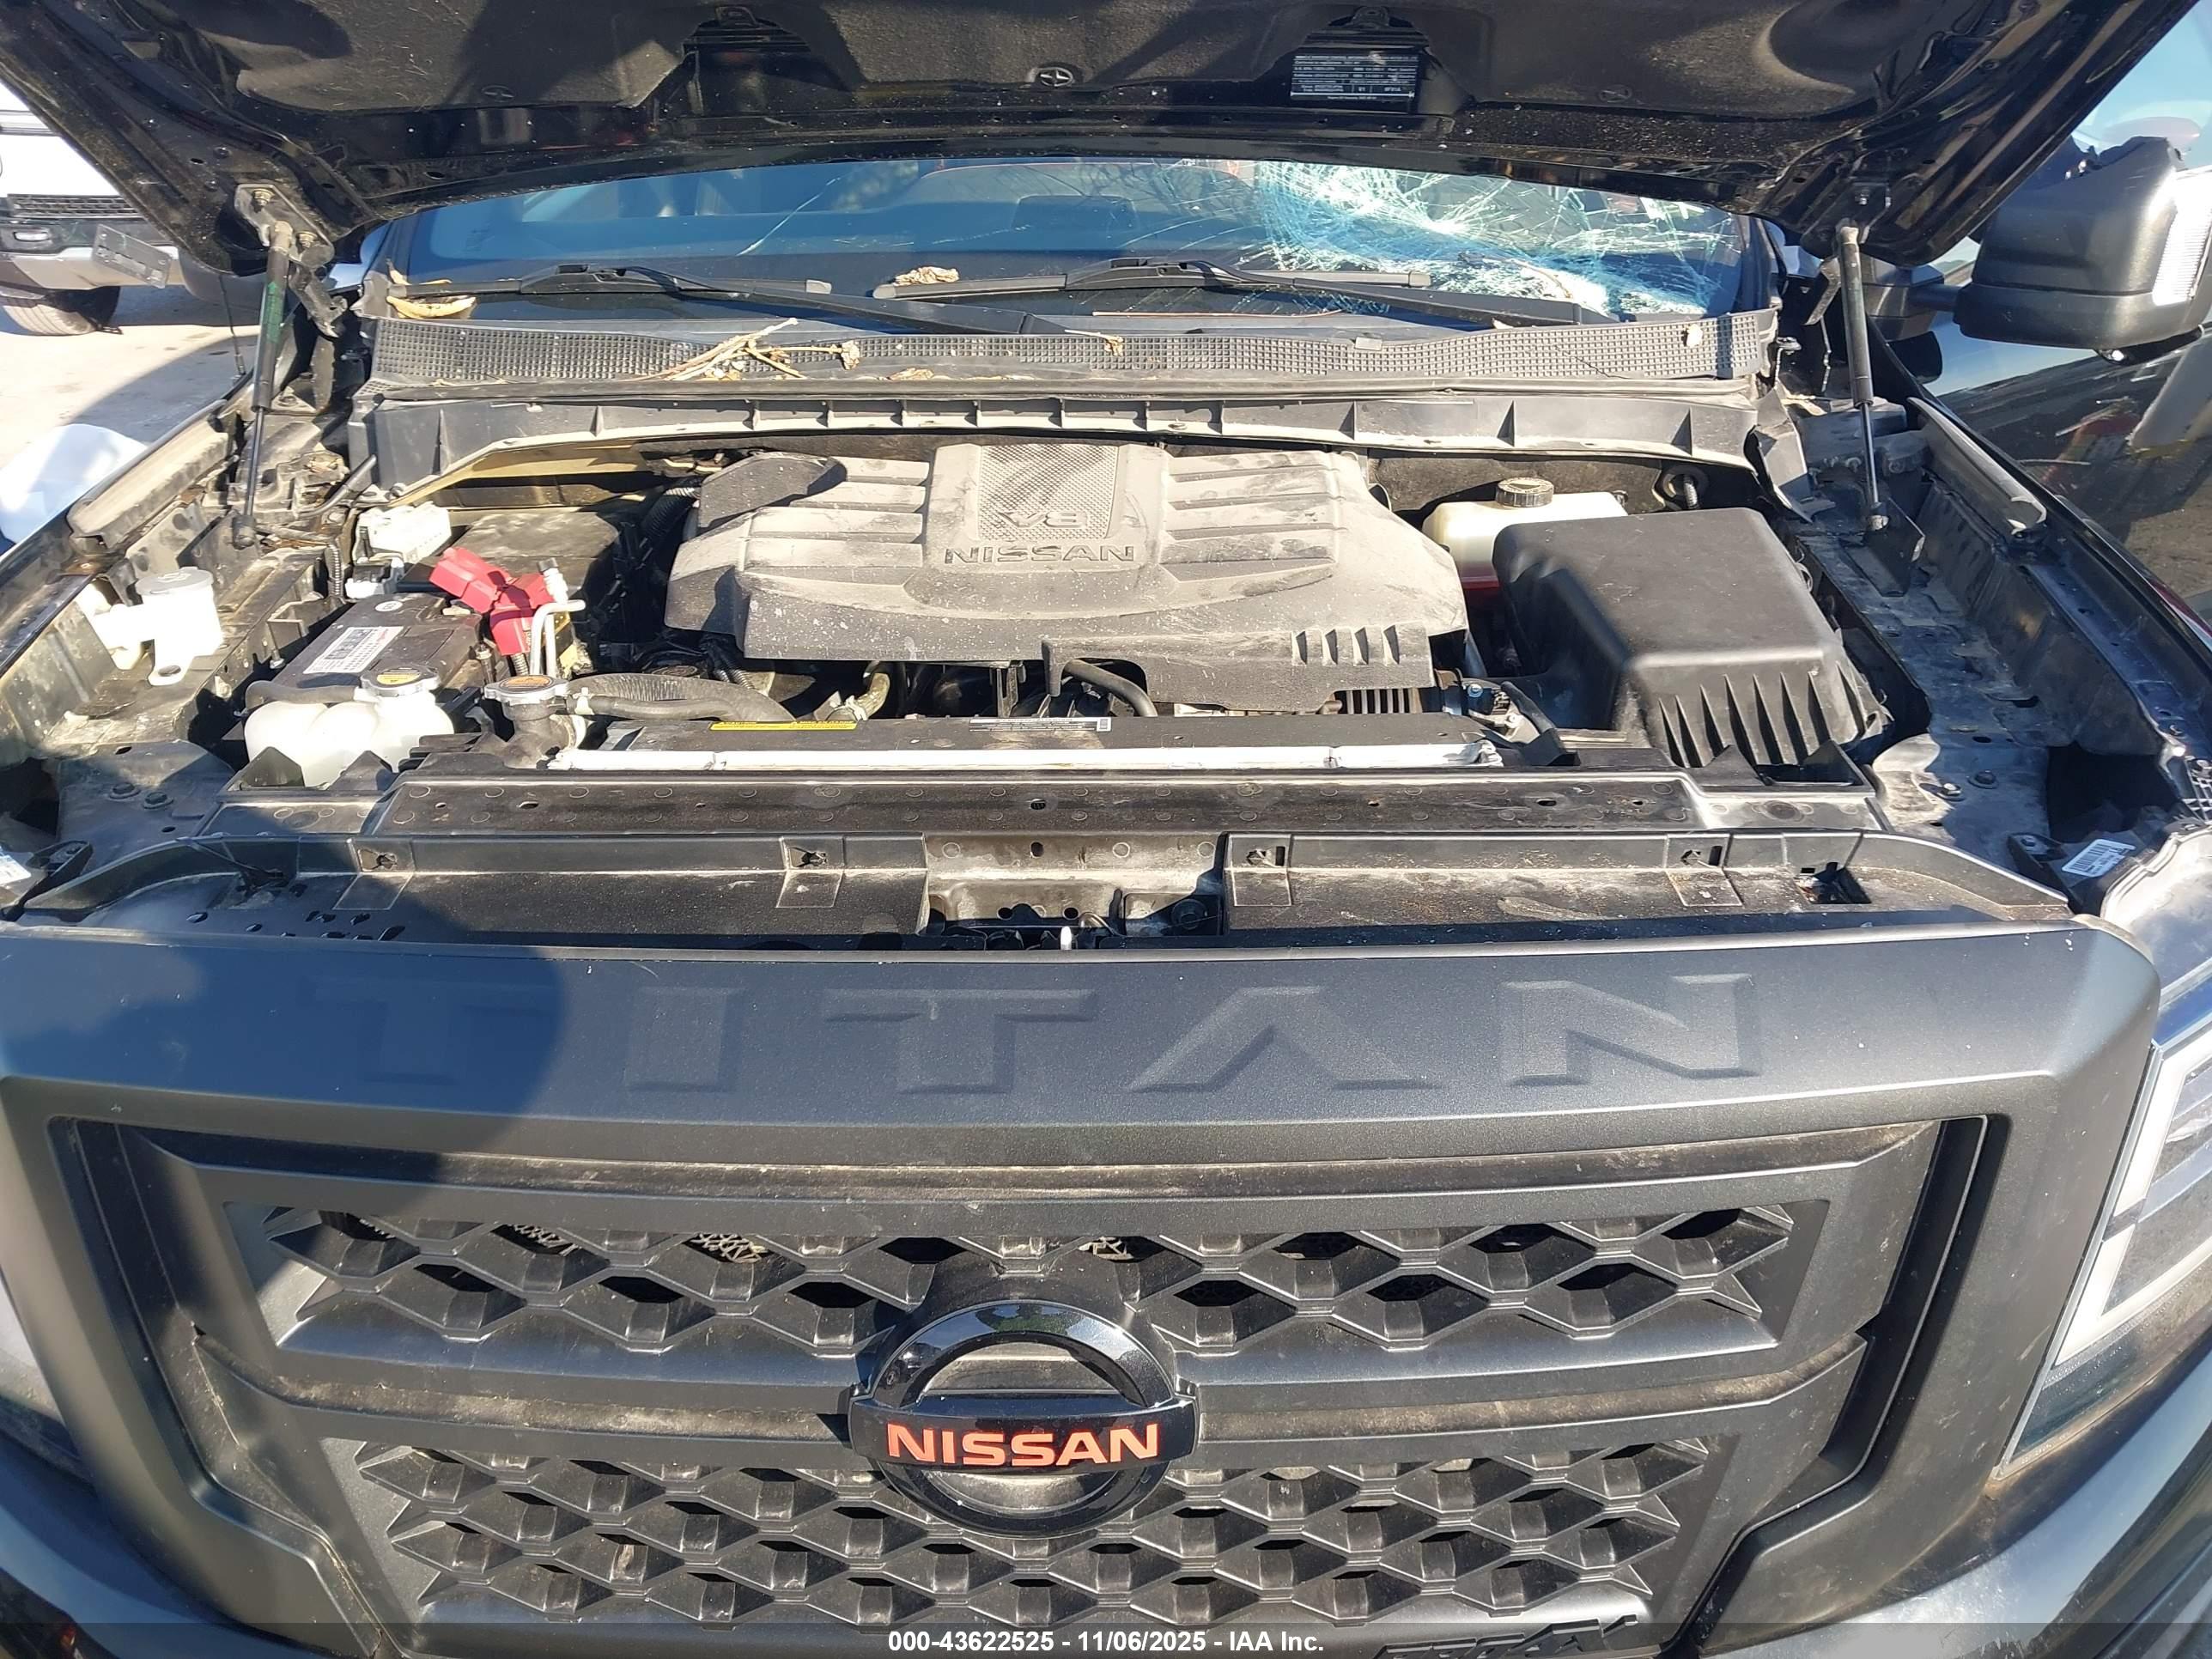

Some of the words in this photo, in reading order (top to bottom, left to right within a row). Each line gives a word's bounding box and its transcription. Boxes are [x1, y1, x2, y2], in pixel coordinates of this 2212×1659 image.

[996, 510, 1089, 529] V8
[944, 544, 1134, 564] NISSAN
[305, 973, 1763, 1095] TITAN
[886, 1422, 1159, 1468] NISSAN
